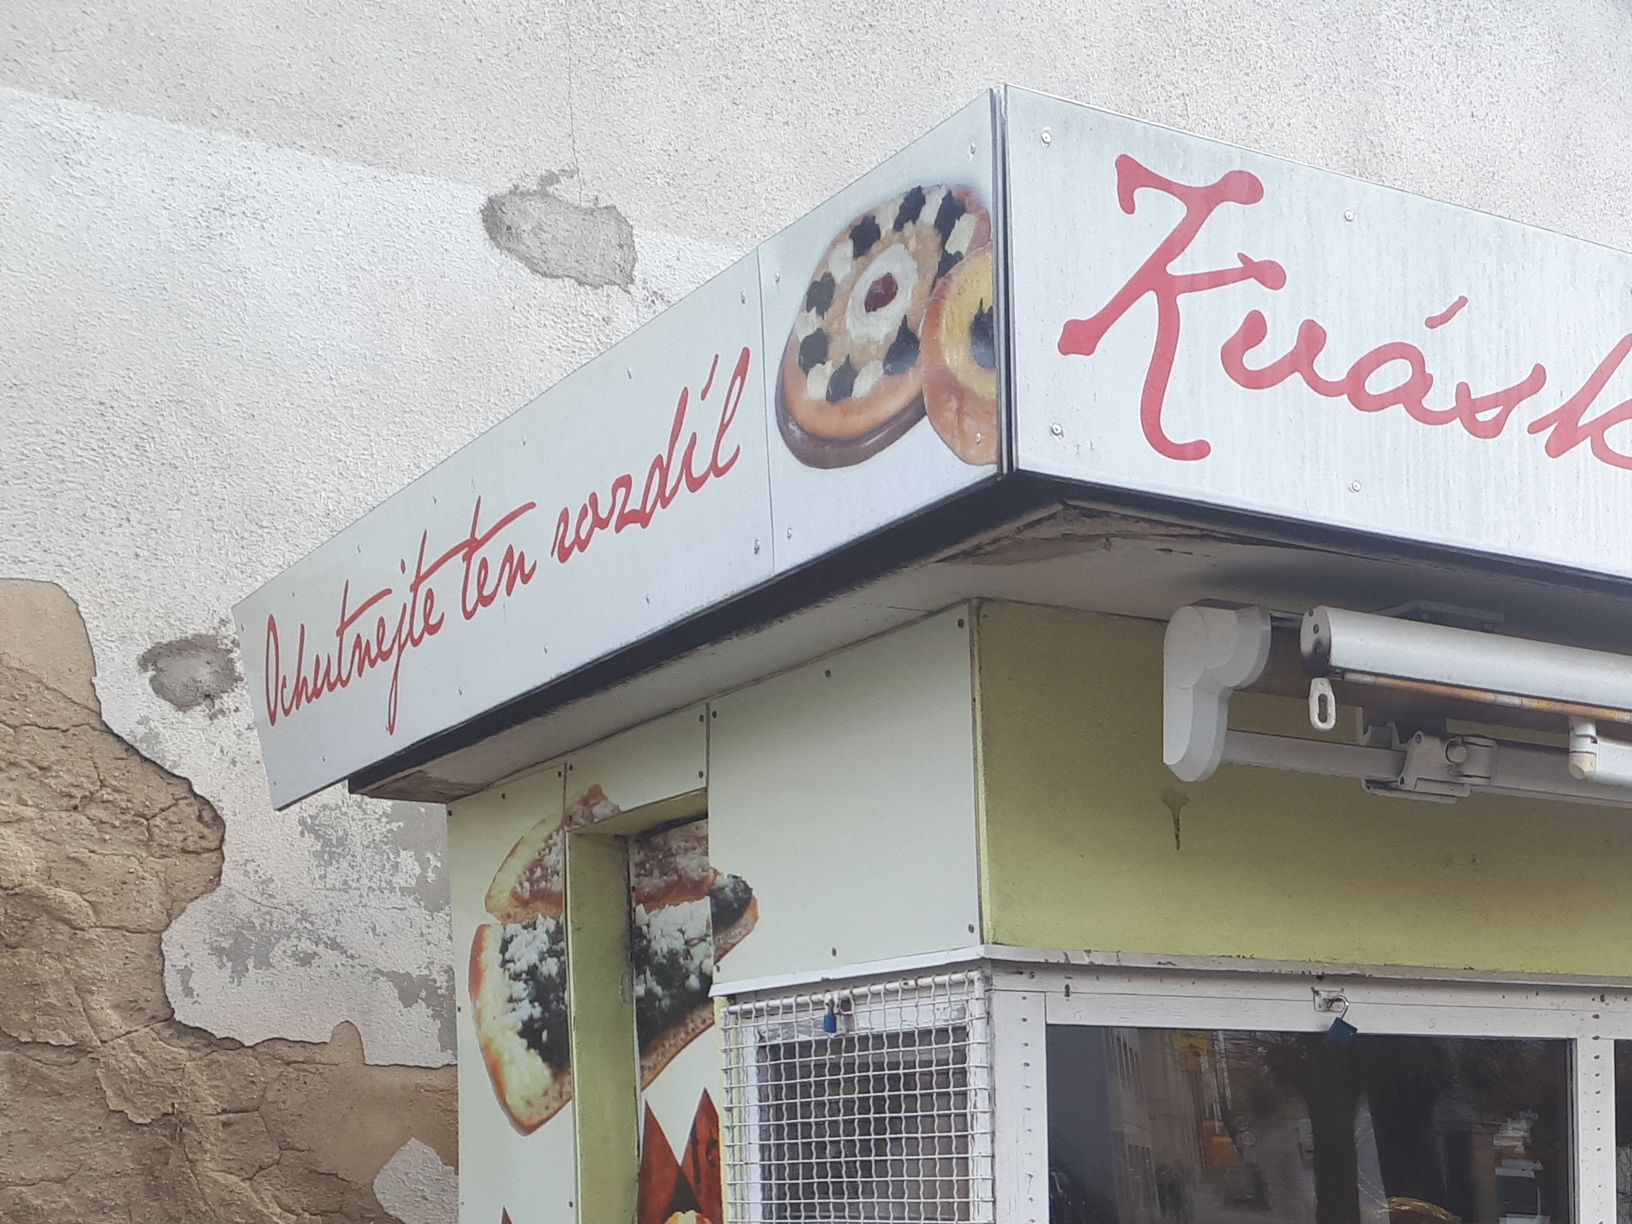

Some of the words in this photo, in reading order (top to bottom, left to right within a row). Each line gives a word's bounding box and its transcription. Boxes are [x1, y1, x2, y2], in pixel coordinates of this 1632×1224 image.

[264, 530, 444, 734] Ochutnejte
[458, 497, 536, 620] ten
[551, 347, 750, 563] rozdíl
